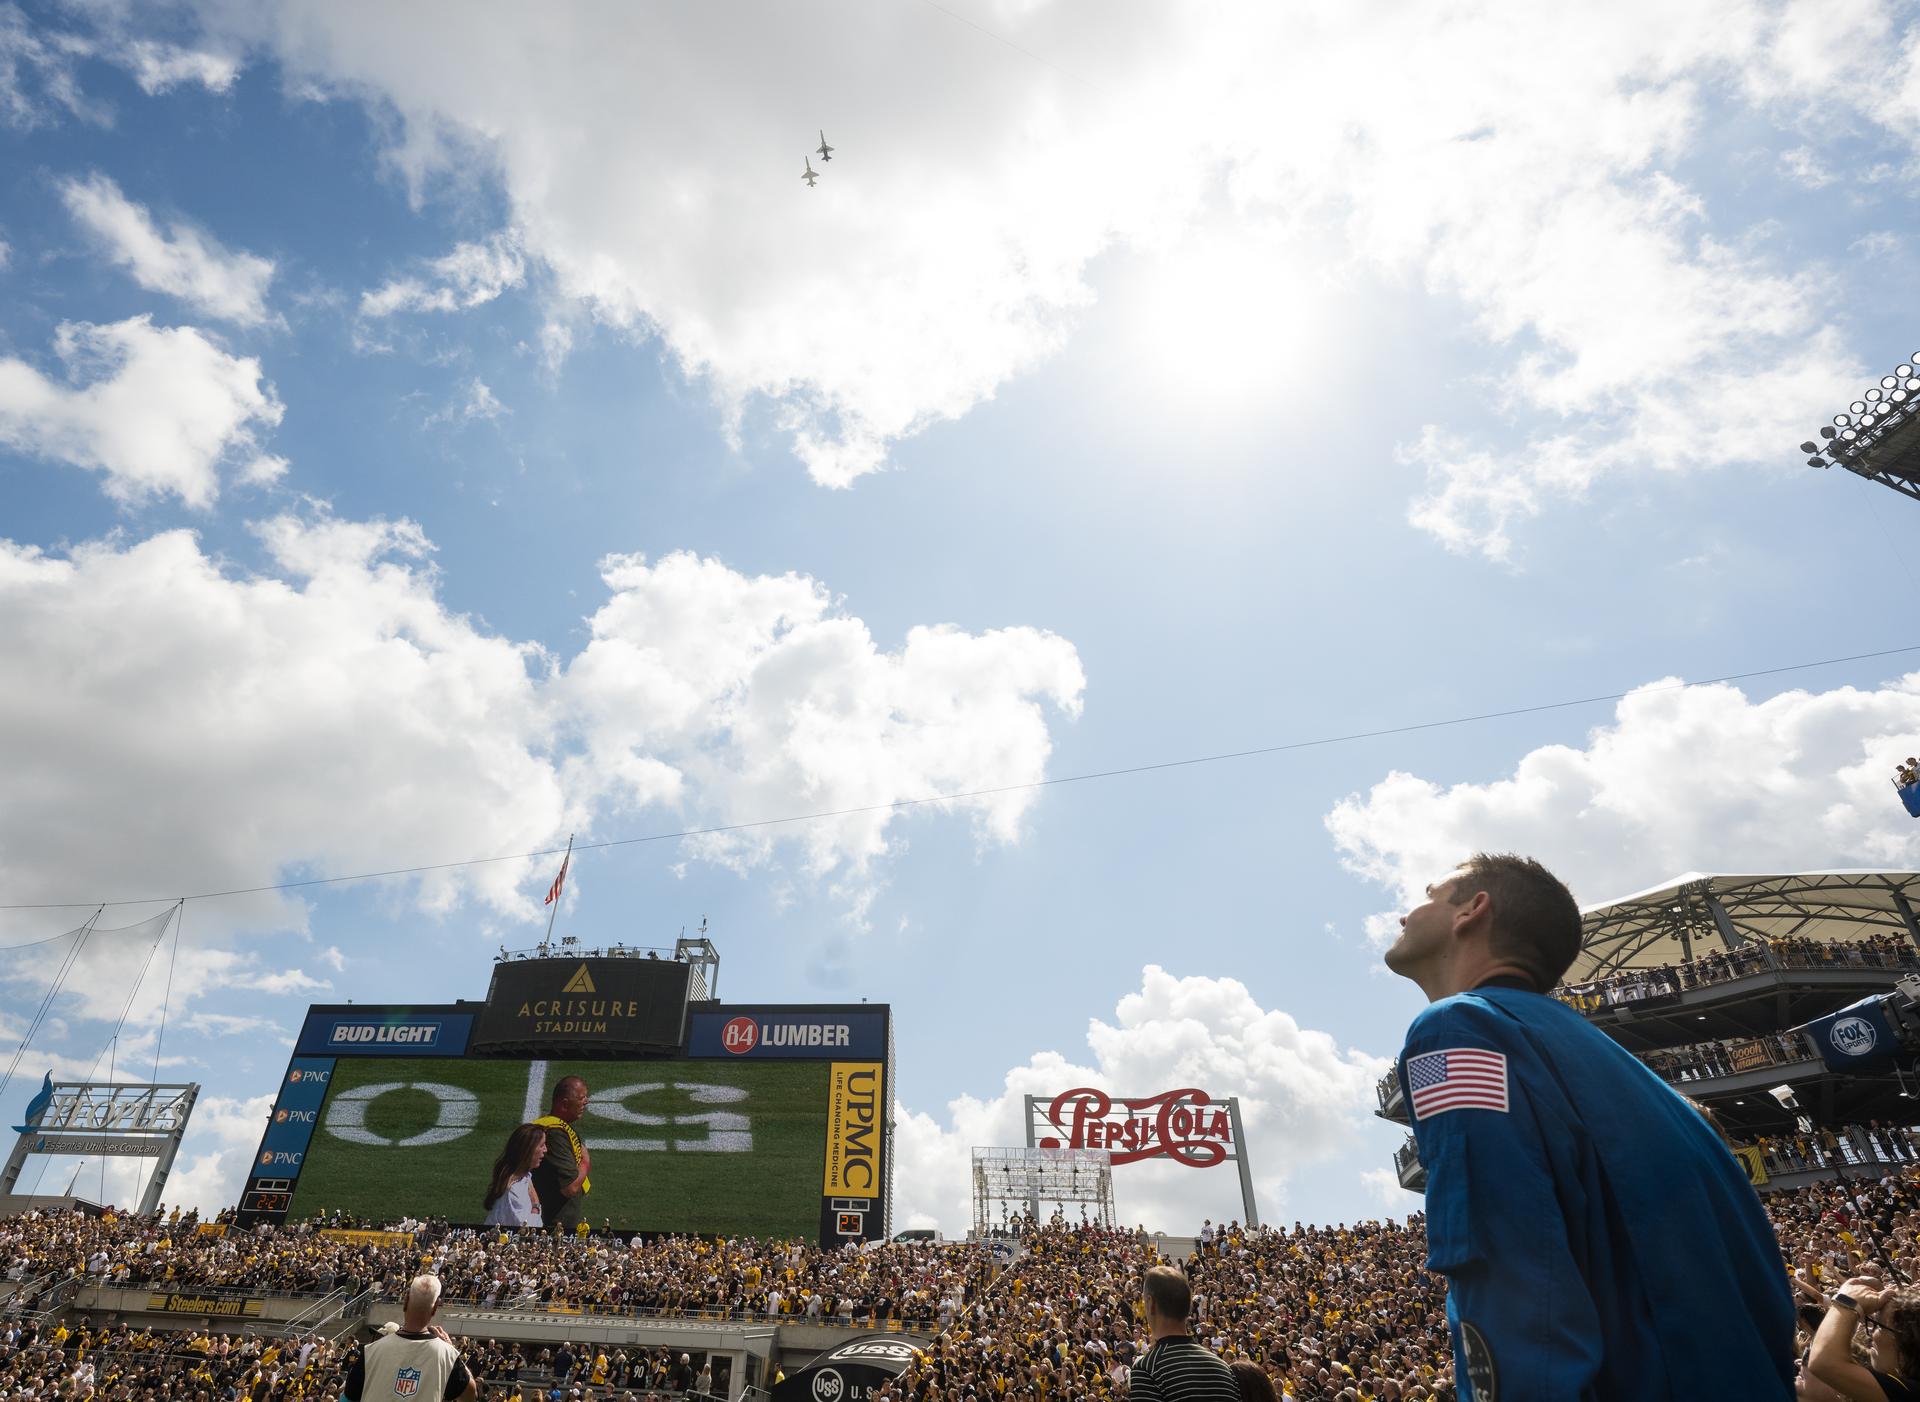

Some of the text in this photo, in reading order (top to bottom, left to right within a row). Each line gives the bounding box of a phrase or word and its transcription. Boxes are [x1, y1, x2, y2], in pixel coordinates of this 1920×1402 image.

[518, 1000, 639, 1017] ACRISURE
[332, 1026, 436, 1043] BUD LIGHT
[535, 1021, 608, 1033] STADIUM
[726, 1024, 850, 1046] 84 LUMBER
[1836, 1022, 1866, 1044] FOX
[302, 1071, 330, 1083] PNC
[50, 1095, 188, 1131] PEOPLES
[288, 1111, 316, 1123] PNC
[833, 1093, 843, 1140] CHANGING
[842, 1069, 876, 1189] UPMC
[22, 1140, 161, 1155] An Essential Utilities Company
[274, 1152, 302, 1165] PNC
[831, 1142, 840, 1188] MEDICINE
[840, 1215, 860, 1232] 25
[168, 1294, 241, 1315] Steelers.com
[633, 1365, 645, 1379] 90
[397, 1379, 416, 1395] NFL
[816, 1377, 840, 1398] USS
